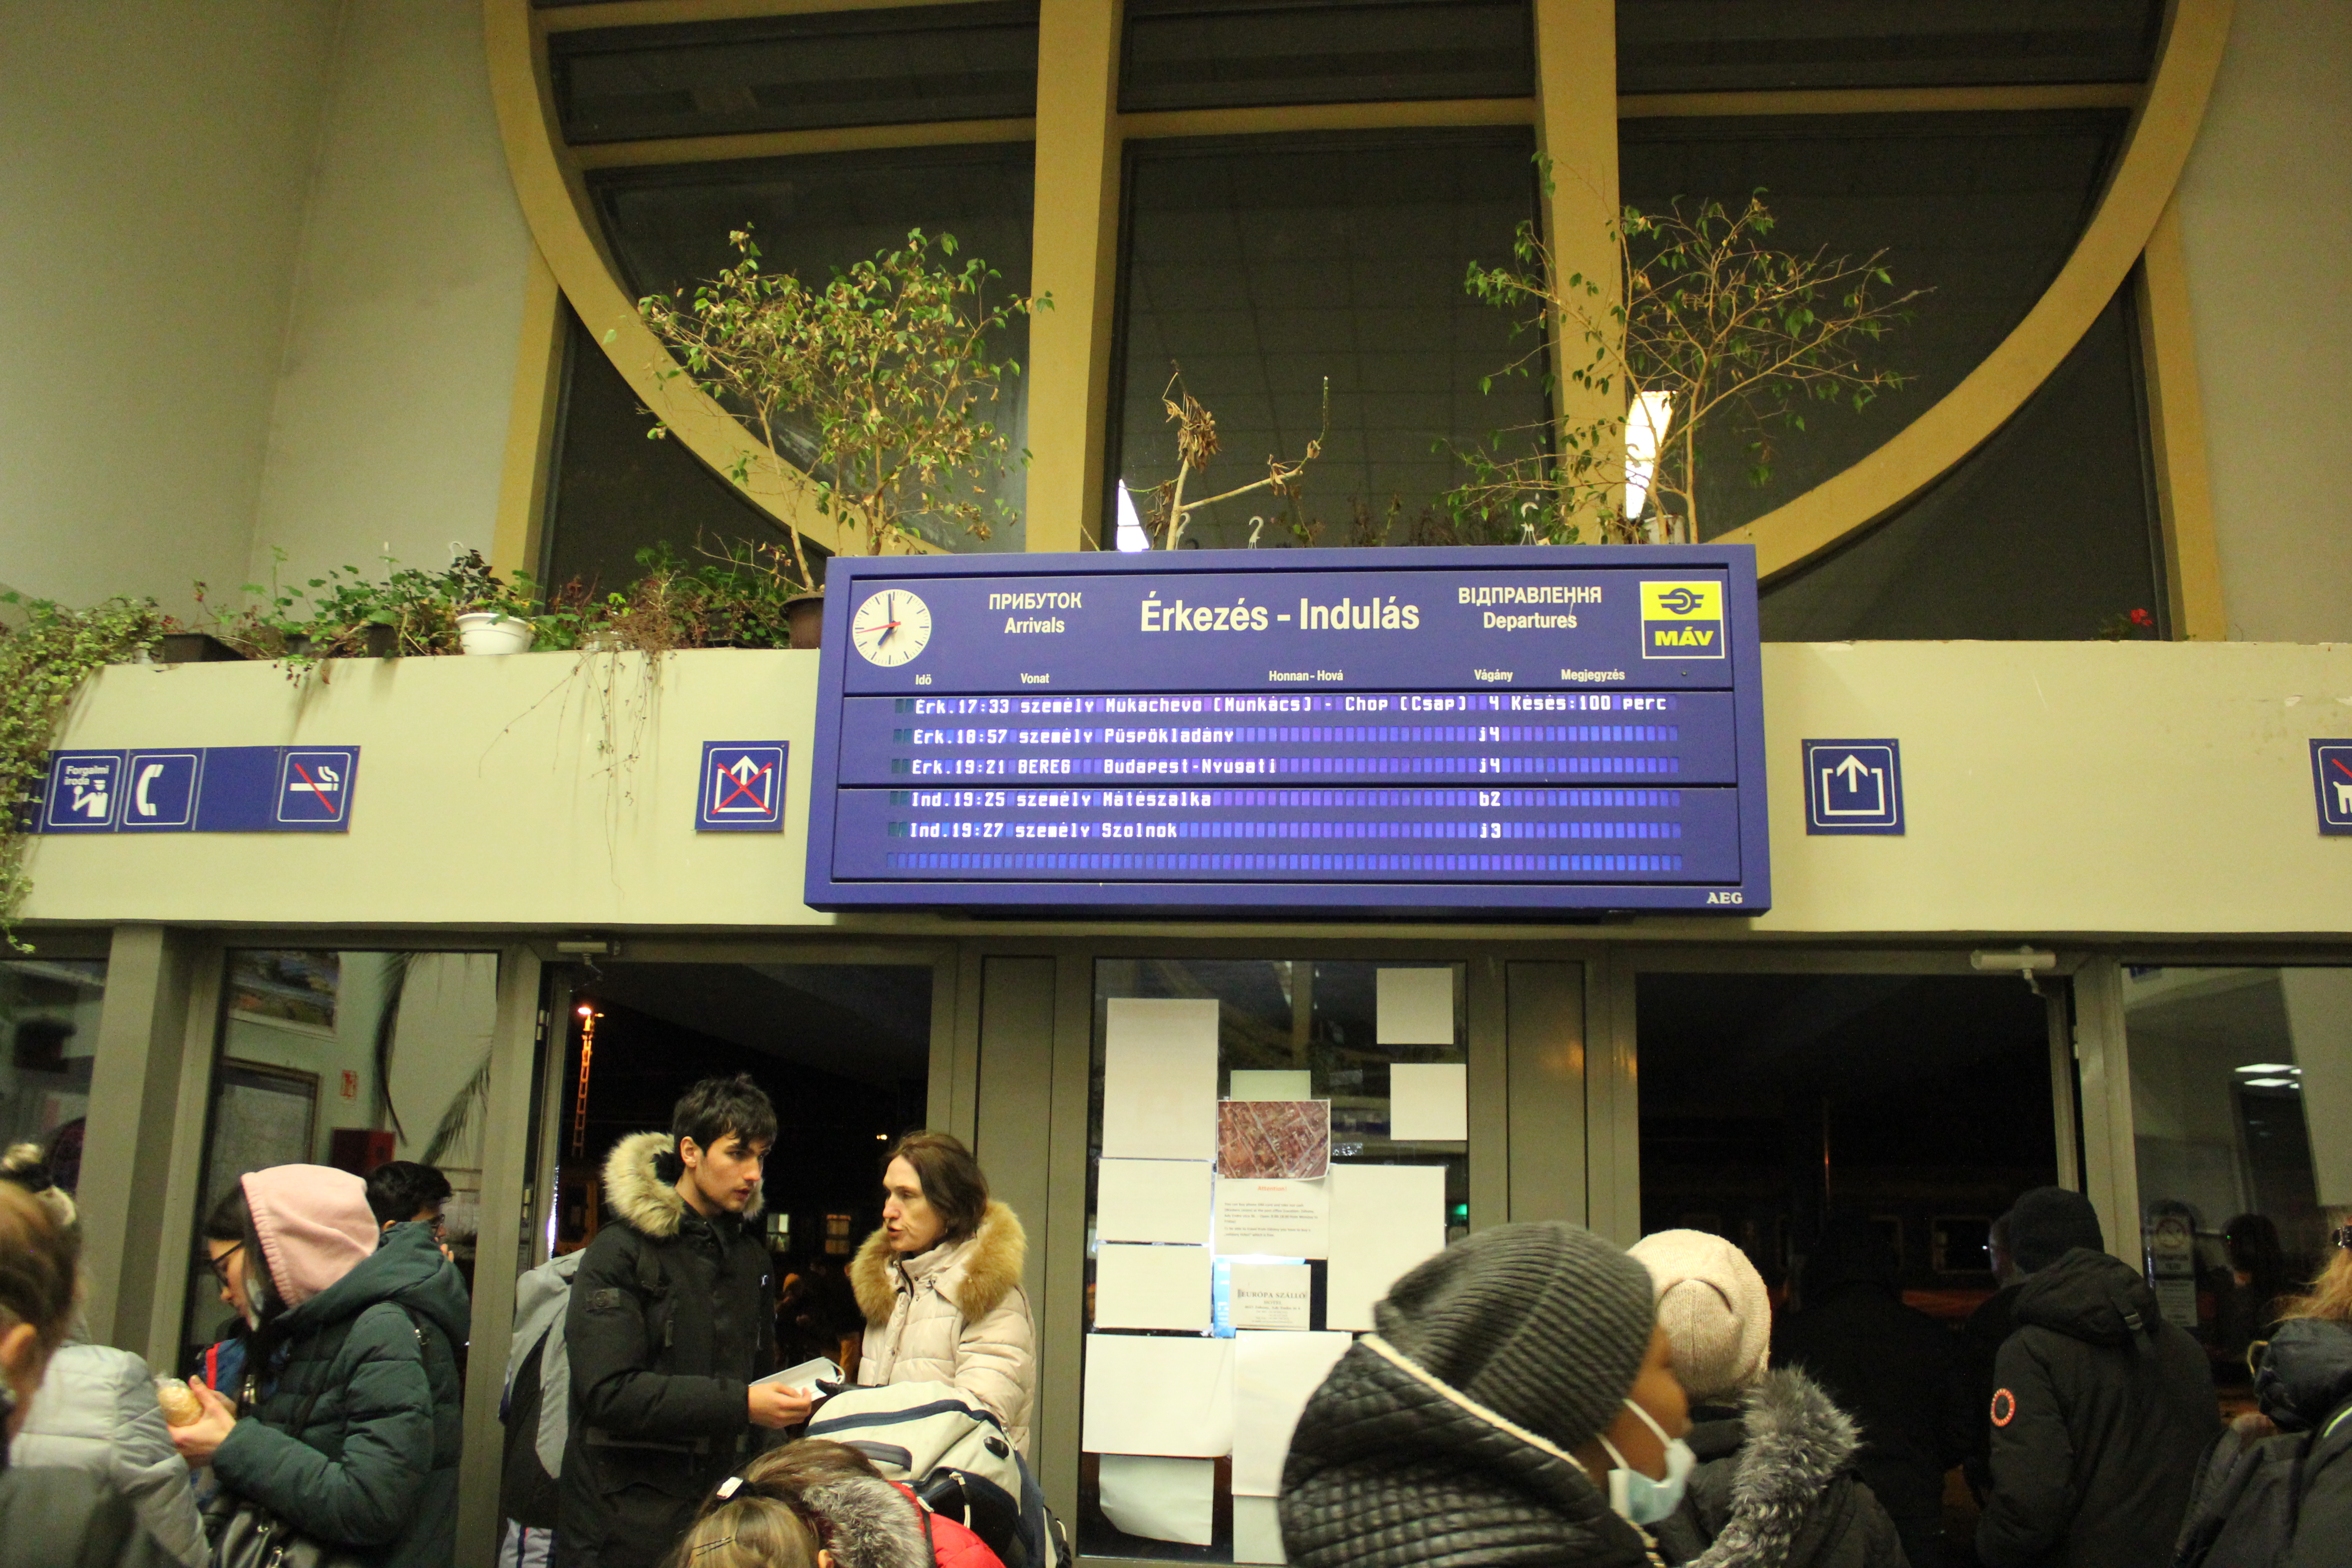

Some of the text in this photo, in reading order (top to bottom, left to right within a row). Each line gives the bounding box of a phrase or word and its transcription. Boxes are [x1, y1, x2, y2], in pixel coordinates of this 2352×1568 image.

[989, 593, 1082, 610] ПРИБУТОК
[1459, 587, 1602, 606] ВІДПРАВЛЕННЯ
[1141, 591, 1269, 632] Érkezés
[1300, 596, 1420, 630] Indulás
[1004, 616, 1065, 634] Arrivals
[1484, 612, 1577, 631] Departures
[1655, 626, 1714, 646] MÁV
[1020, 673, 1050, 684] Vonat
[1317, 670, 1343, 681] Hová
[1474, 669, 1513, 681] Vágány
[1561, 669, 1626, 682] Megjegyzés
[1021, 698, 1094, 713] személy
[1106, 697, 1202, 712] Mukachevo
[1346, 696, 1388, 711] Chop
[1489, 696, 1499, 710] 4
[1623, 698, 1666, 710] perc
[1019, 728, 1093, 743] személy
[1104, 727, 1234, 743] Püspökladány
[1479, 726, 1499, 742] j4
[65, 765, 110, 776] Forgalmi
[1104, 759, 1275, 774] Budapest-Nyugati
[1479, 758, 1500, 773] j4
[64, 776, 90, 785] iroda
[1017, 791, 1090, 806] személy
[1103, 791, 1211, 806] Mátészalka
[1480, 792, 1500, 807] b2
[1016, 822, 1089, 837] személy
[1102, 823, 1177, 838] Szolnok
[1480, 823, 1501, 838] j3
[1706, 892, 1743, 904] AEG
